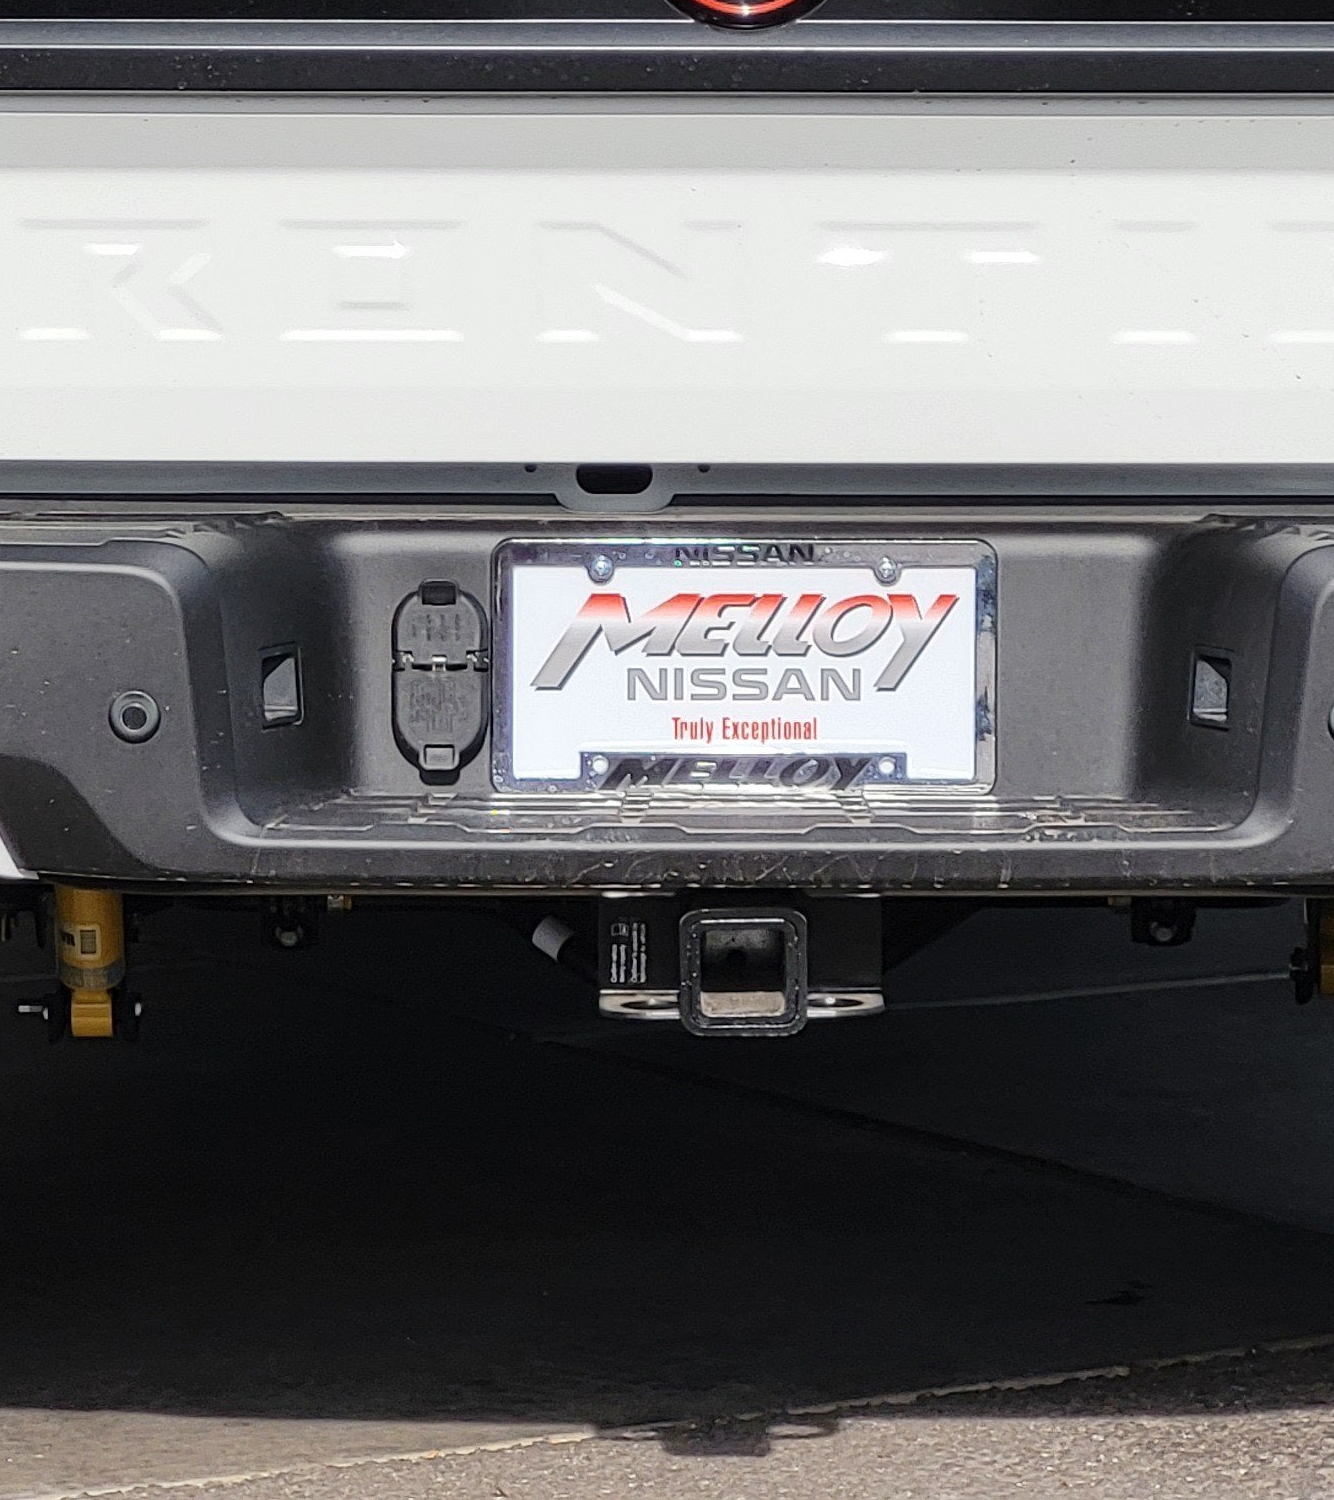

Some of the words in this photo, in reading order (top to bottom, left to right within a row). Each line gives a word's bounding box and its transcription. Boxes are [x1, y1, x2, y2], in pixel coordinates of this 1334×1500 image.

[674, 543, 816, 566] NISSAN
[530, 592, 960, 692] MELLOY
[626, 667, 862, 701] NISSAN
[671, 716, 713, 744] Truly
[722, 716, 818, 744] Exceptional
[595, 754, 875, 793] MELLOY
